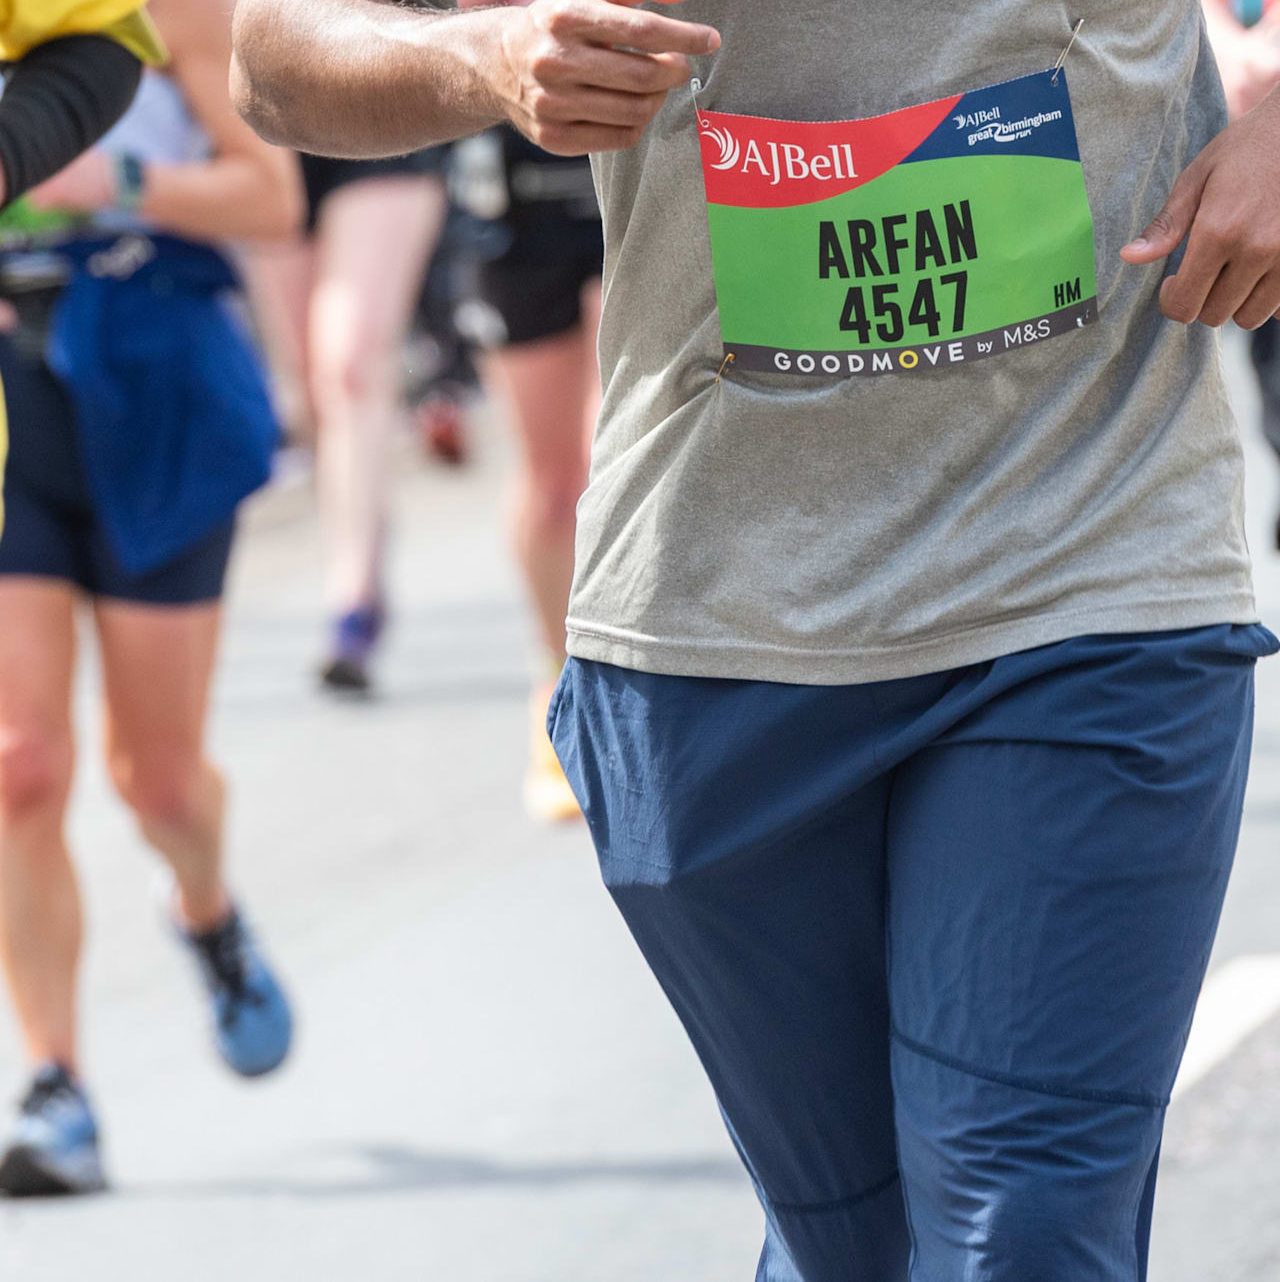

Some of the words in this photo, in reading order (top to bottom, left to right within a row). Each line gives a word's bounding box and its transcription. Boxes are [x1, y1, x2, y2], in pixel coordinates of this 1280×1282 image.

[965, 106, 1000, 127] AJBell
[968, 128, 993, 146] great
[1001, 110, 1062, 135] birmingham
[1015, 128, 1033, 140] run
[740, 139, 858, 185] AJBell
[819, 199, 979, 279] ARFAN
[839, 270, 968, 344] 4547
[1053, 277, 1081, 308] HM
[773, 341, 965, 374] GOODMOVE
[976, 339, 993, 354] by
[1003, 319, 1051, 349] M&S
